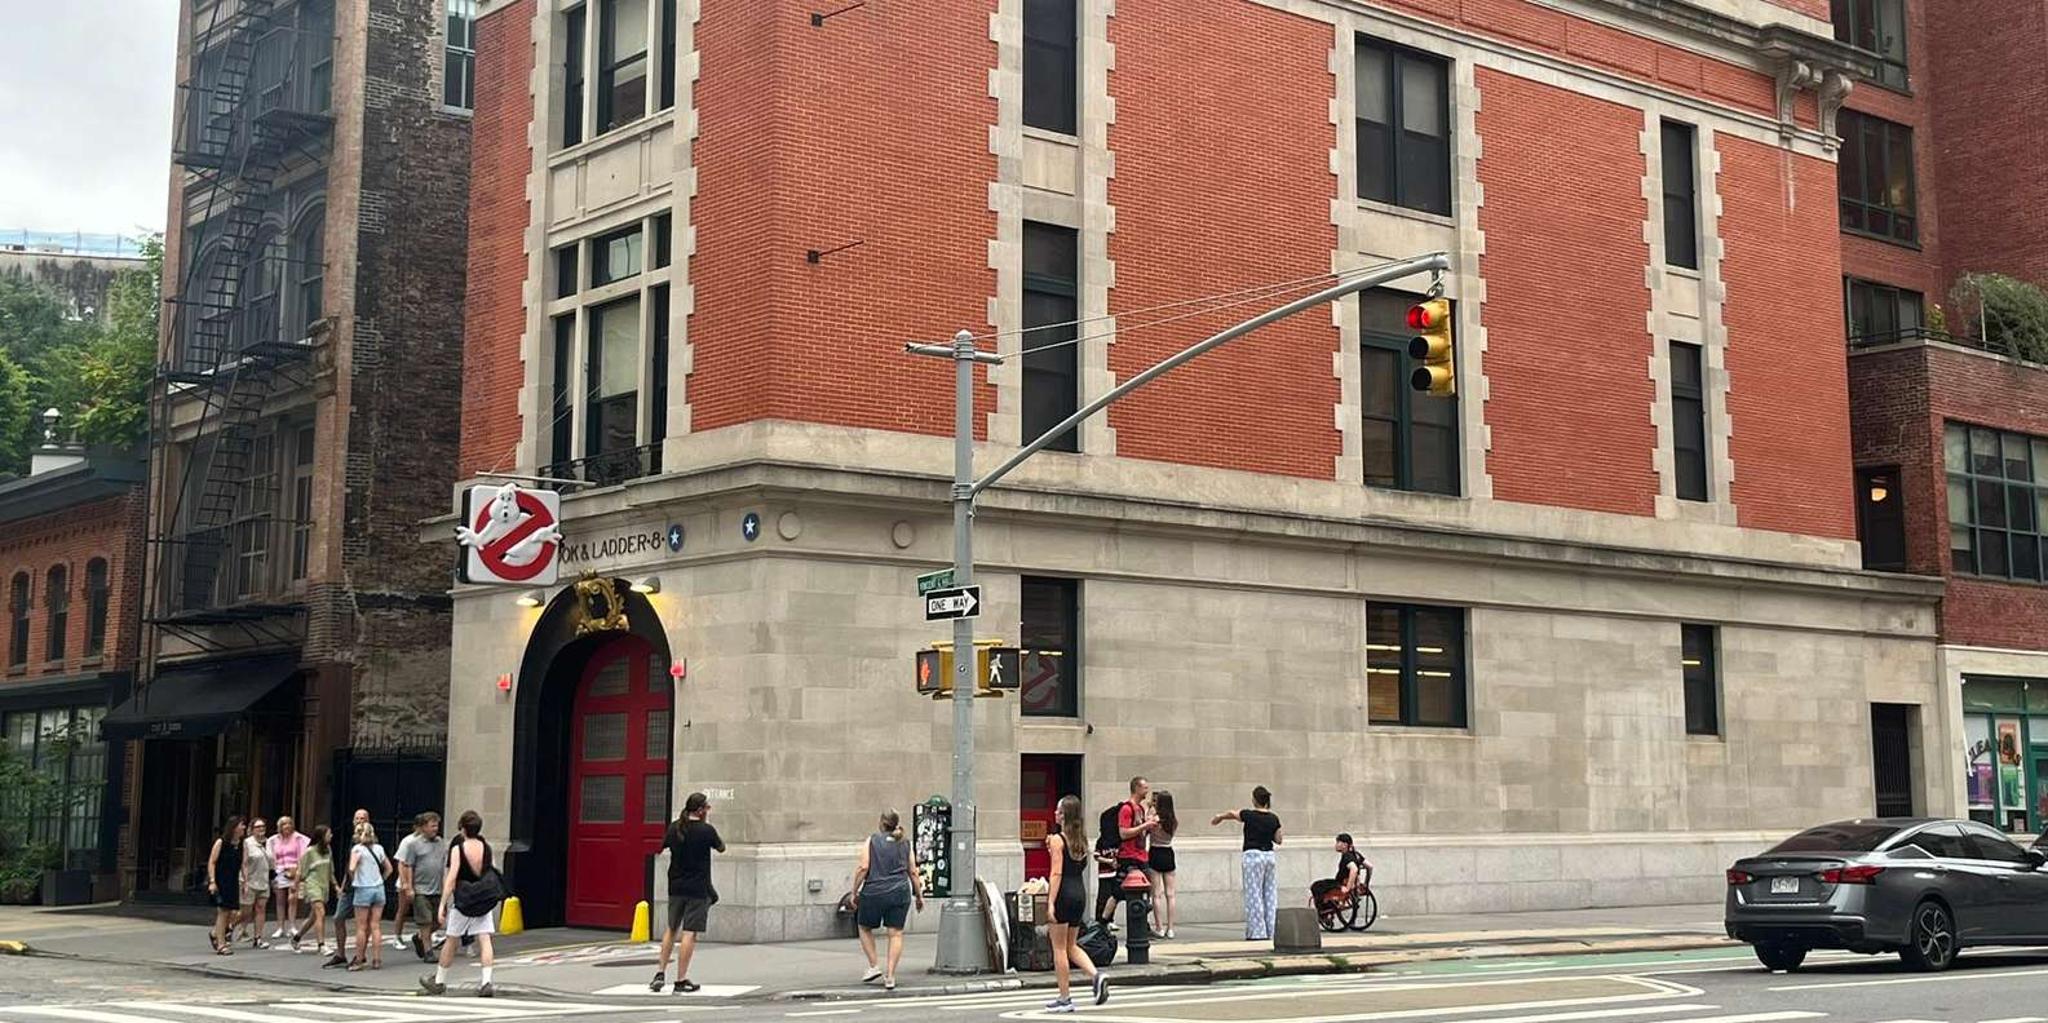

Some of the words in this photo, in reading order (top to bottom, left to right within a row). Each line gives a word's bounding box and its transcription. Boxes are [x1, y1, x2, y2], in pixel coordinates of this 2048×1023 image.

[581, 543, 589, 560] &
[931, 599, 946, 611] ONE
[953, 597, 969, 609] WAY
